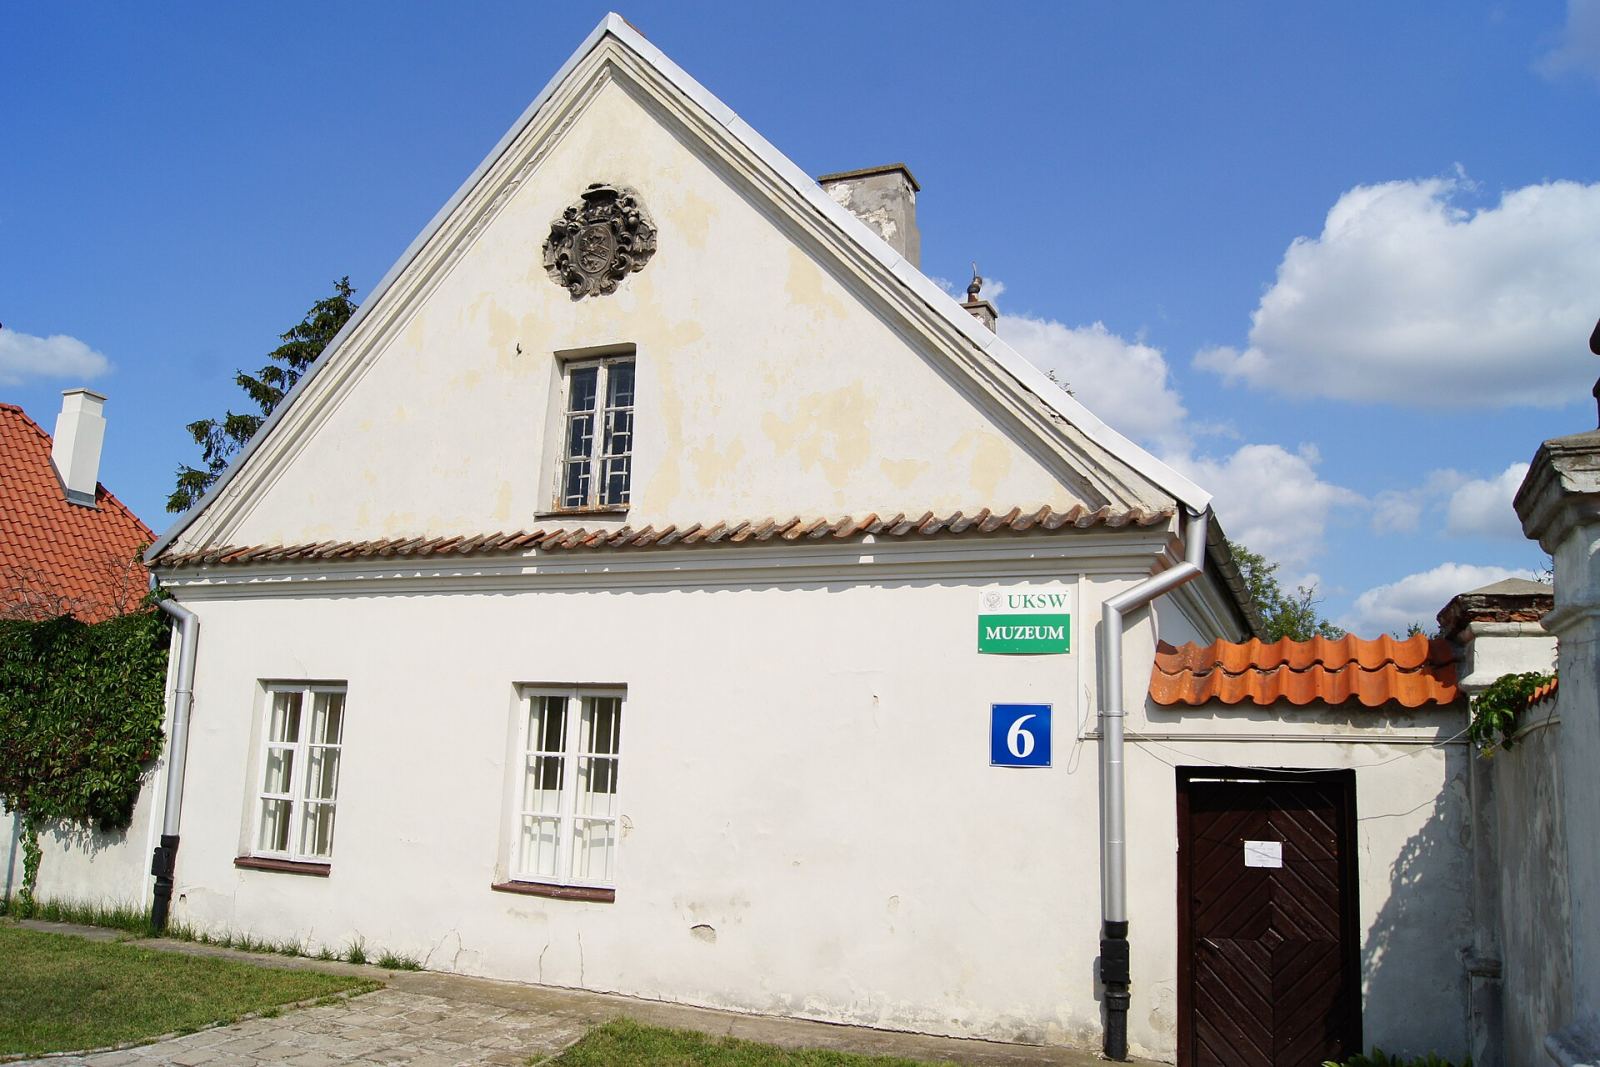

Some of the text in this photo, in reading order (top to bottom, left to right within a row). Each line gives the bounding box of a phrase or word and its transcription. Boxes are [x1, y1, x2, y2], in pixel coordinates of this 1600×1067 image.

[1008, 594, 1067, 609] UKSW
[985, 626, 1065, 641] MUZEUM
[1007, 714, 1037, 758] 6
